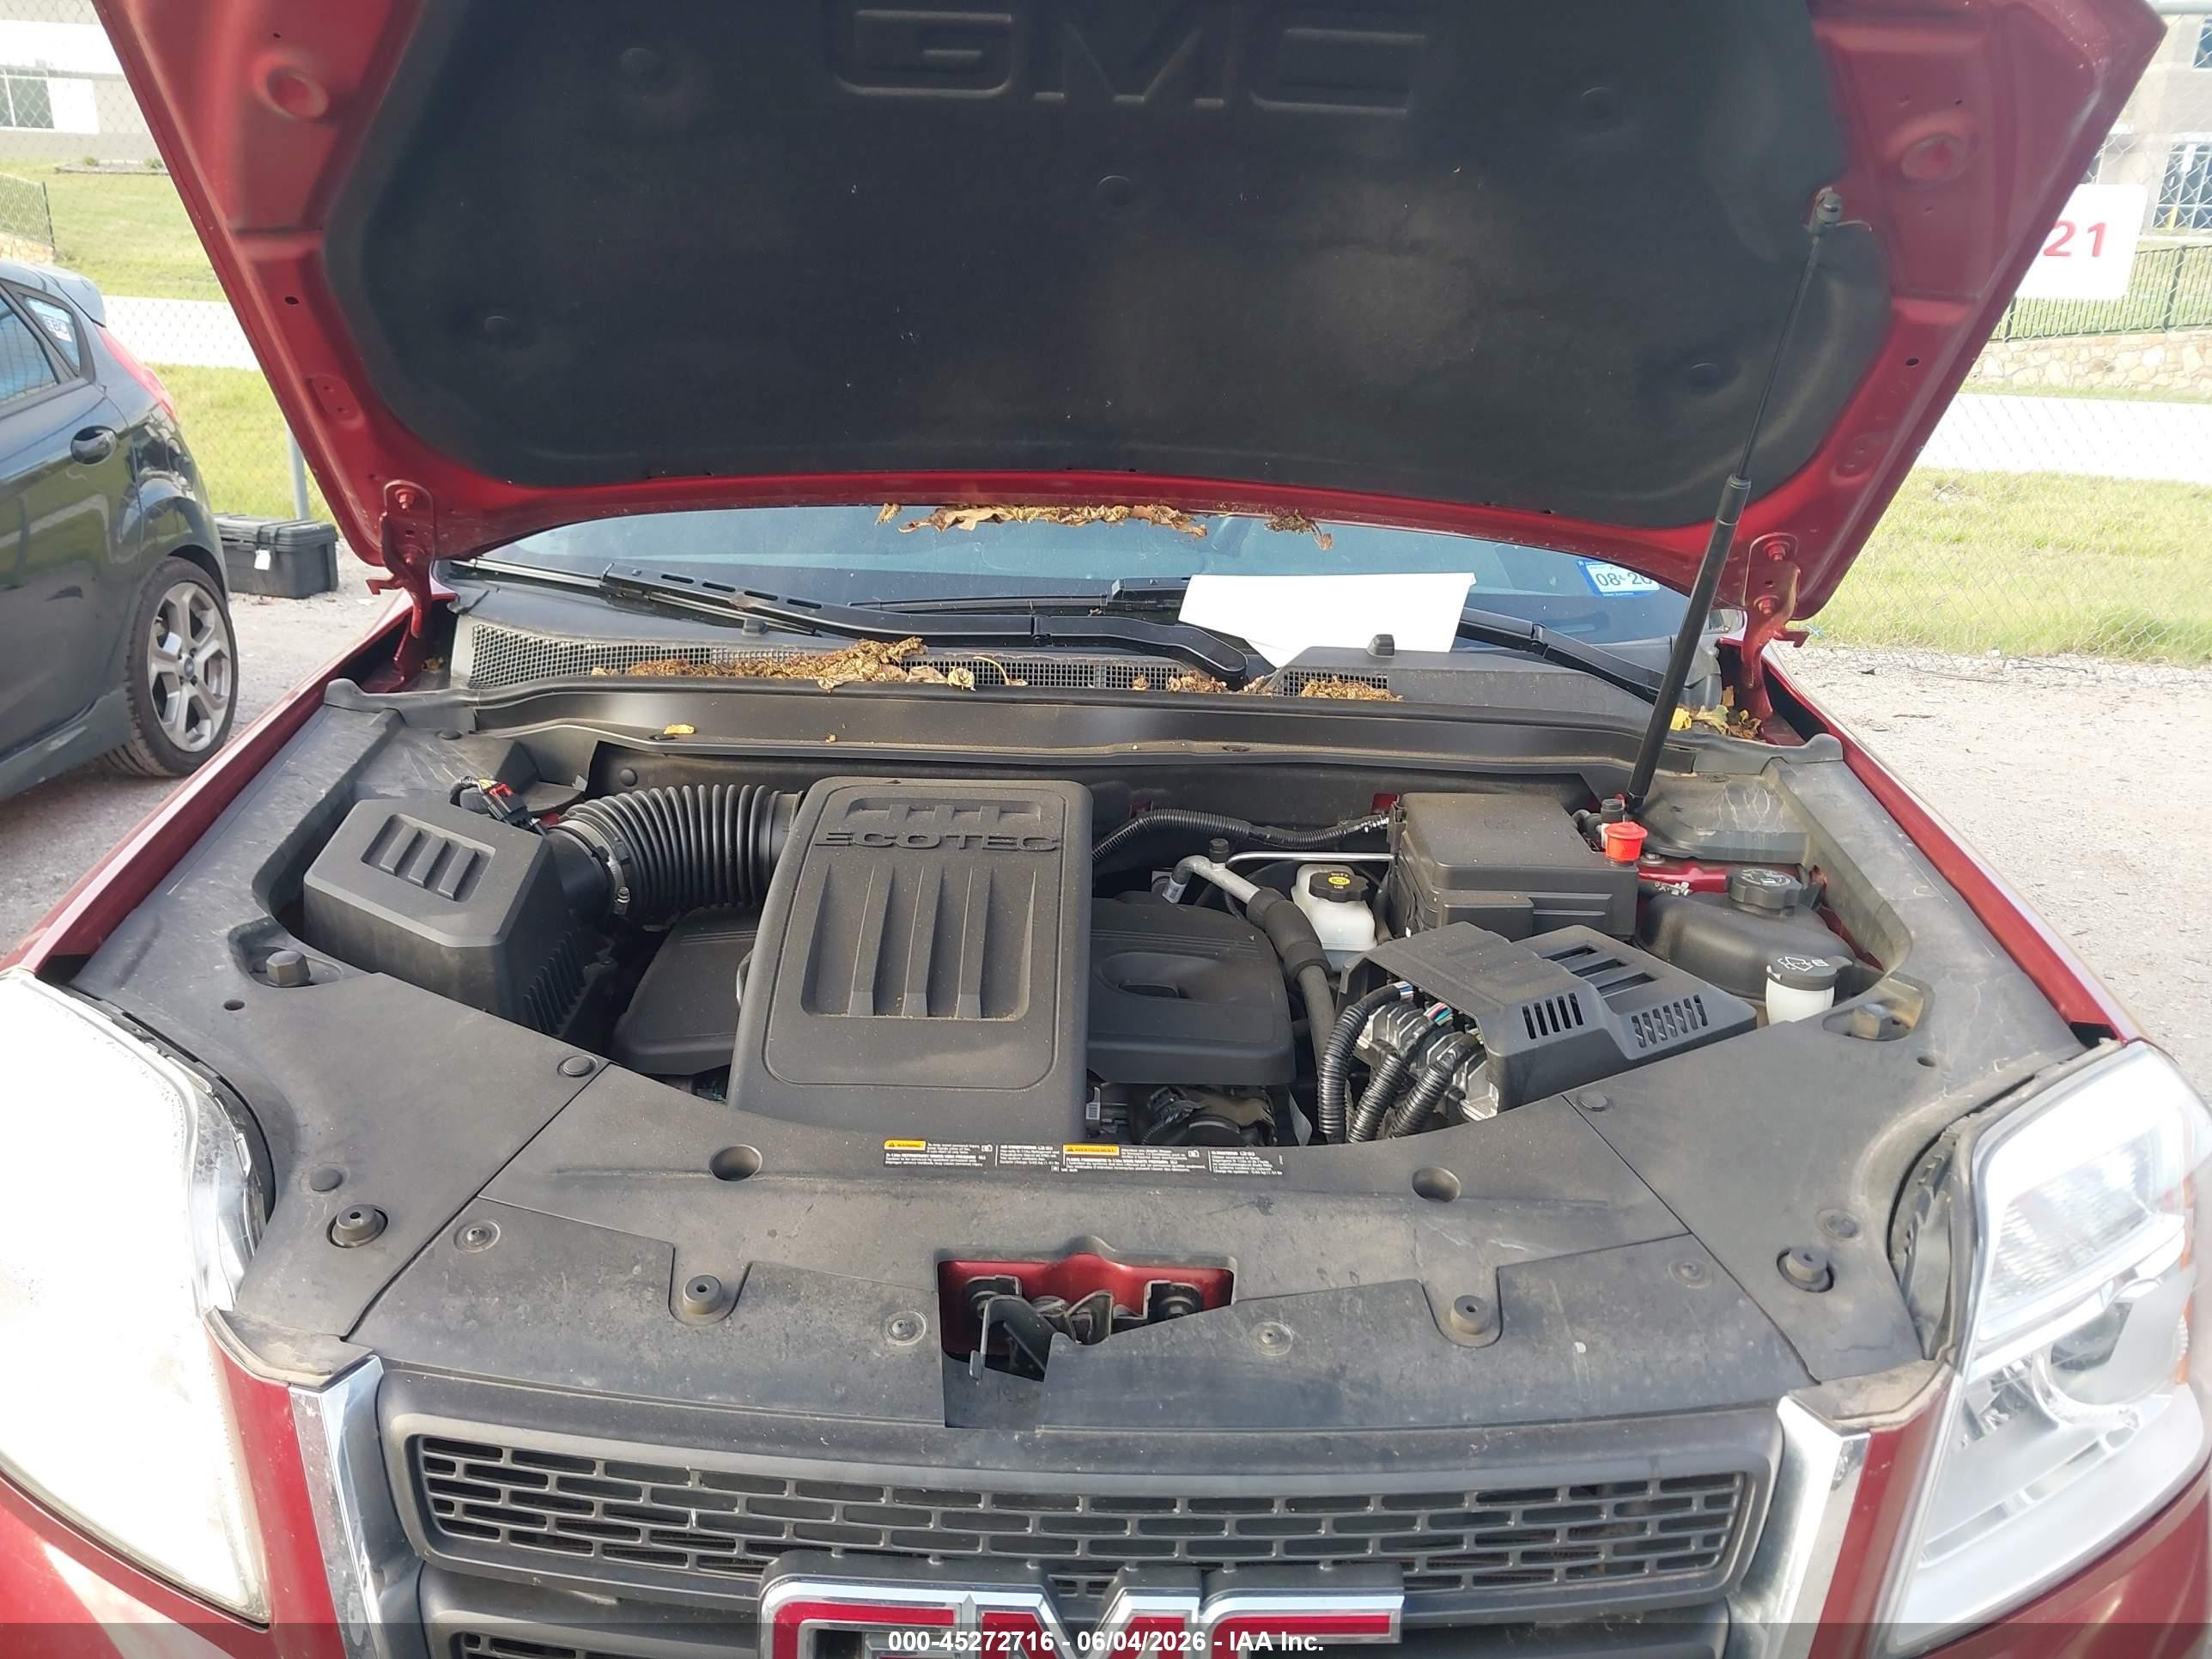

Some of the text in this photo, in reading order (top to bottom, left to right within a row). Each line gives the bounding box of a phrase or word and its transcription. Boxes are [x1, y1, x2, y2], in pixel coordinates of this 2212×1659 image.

[830, 9, 1428, 117] GMC
[2044, 220, 2106, 258] 21
[1595, 573, 1621, 586] 08
[815, 832, 1060, 853] ECOTEC
